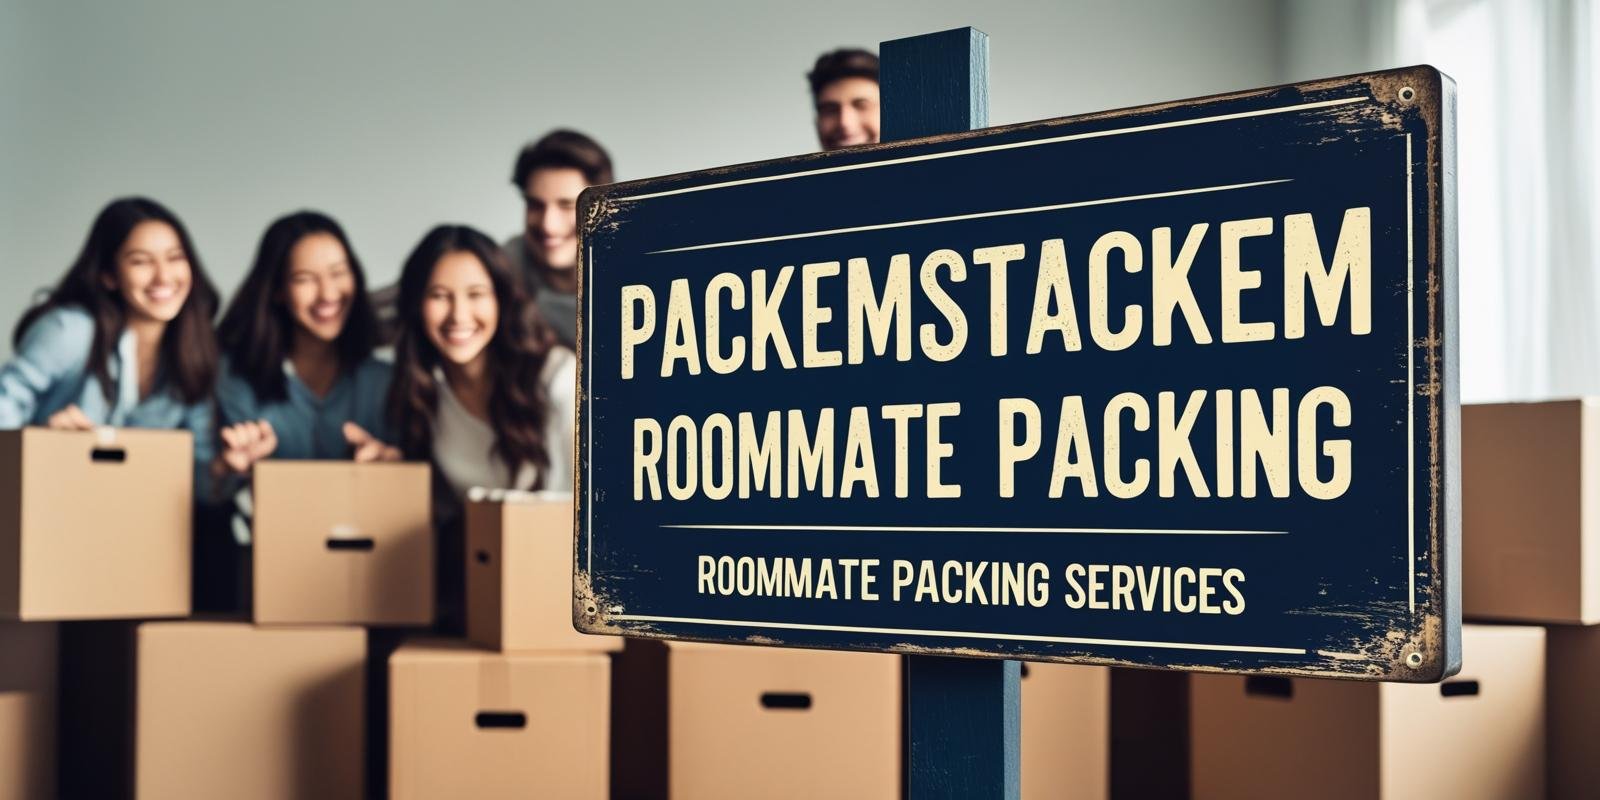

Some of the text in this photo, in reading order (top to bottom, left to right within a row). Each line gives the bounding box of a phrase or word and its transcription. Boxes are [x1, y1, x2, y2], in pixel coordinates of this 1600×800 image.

[621, 206, 1372, 380] PACKEMSTACKEM
[633, 385, 1352, 501] ROOMMATE PACKING
[697, 555, 1246, 615] ROOMMATE PACKING SERVICES
